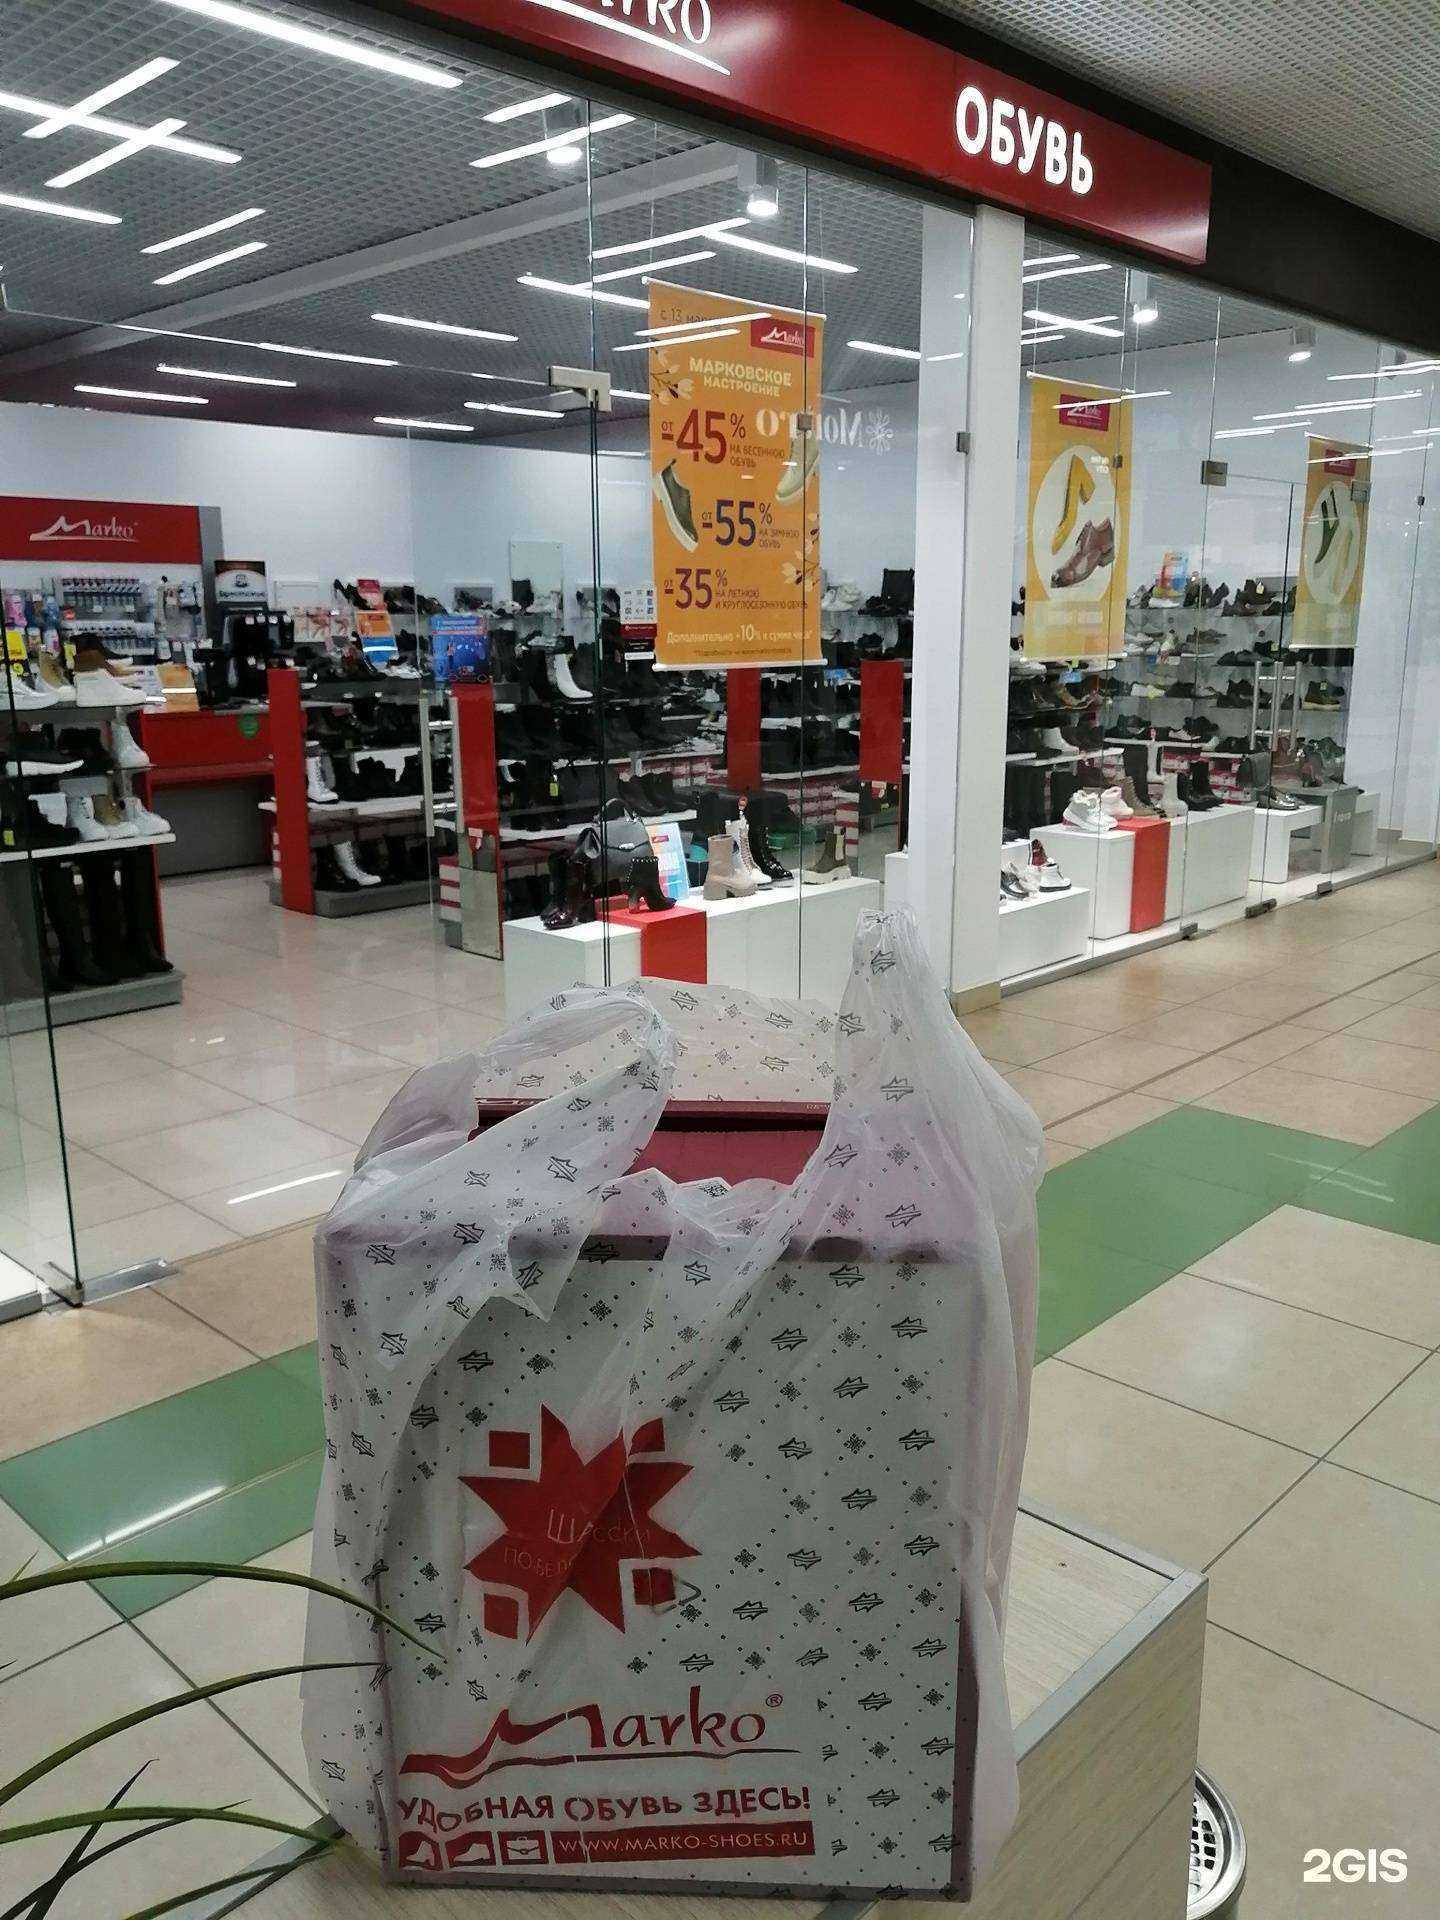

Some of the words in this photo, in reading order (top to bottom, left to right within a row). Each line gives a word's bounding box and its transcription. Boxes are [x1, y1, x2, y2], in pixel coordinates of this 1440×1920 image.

[955, 86, 1094, 194] ОБУВЬ
[689, 357, 792, 387] МАРКОВСКОЕ
[704, 376, 780, 397] НАСТРОЕНИЕ
[30, 516, 135, 541] Marko
[397, 1795, 554, 1834] УДОБНАЯ
[564, 1796, 683, 1822] ОБУВЬ
[693, 1786, 811, 1818] ЗДЕСЬ!
[560, 1831, 808, 1853] WWW.MARKO-SHOES.RU
